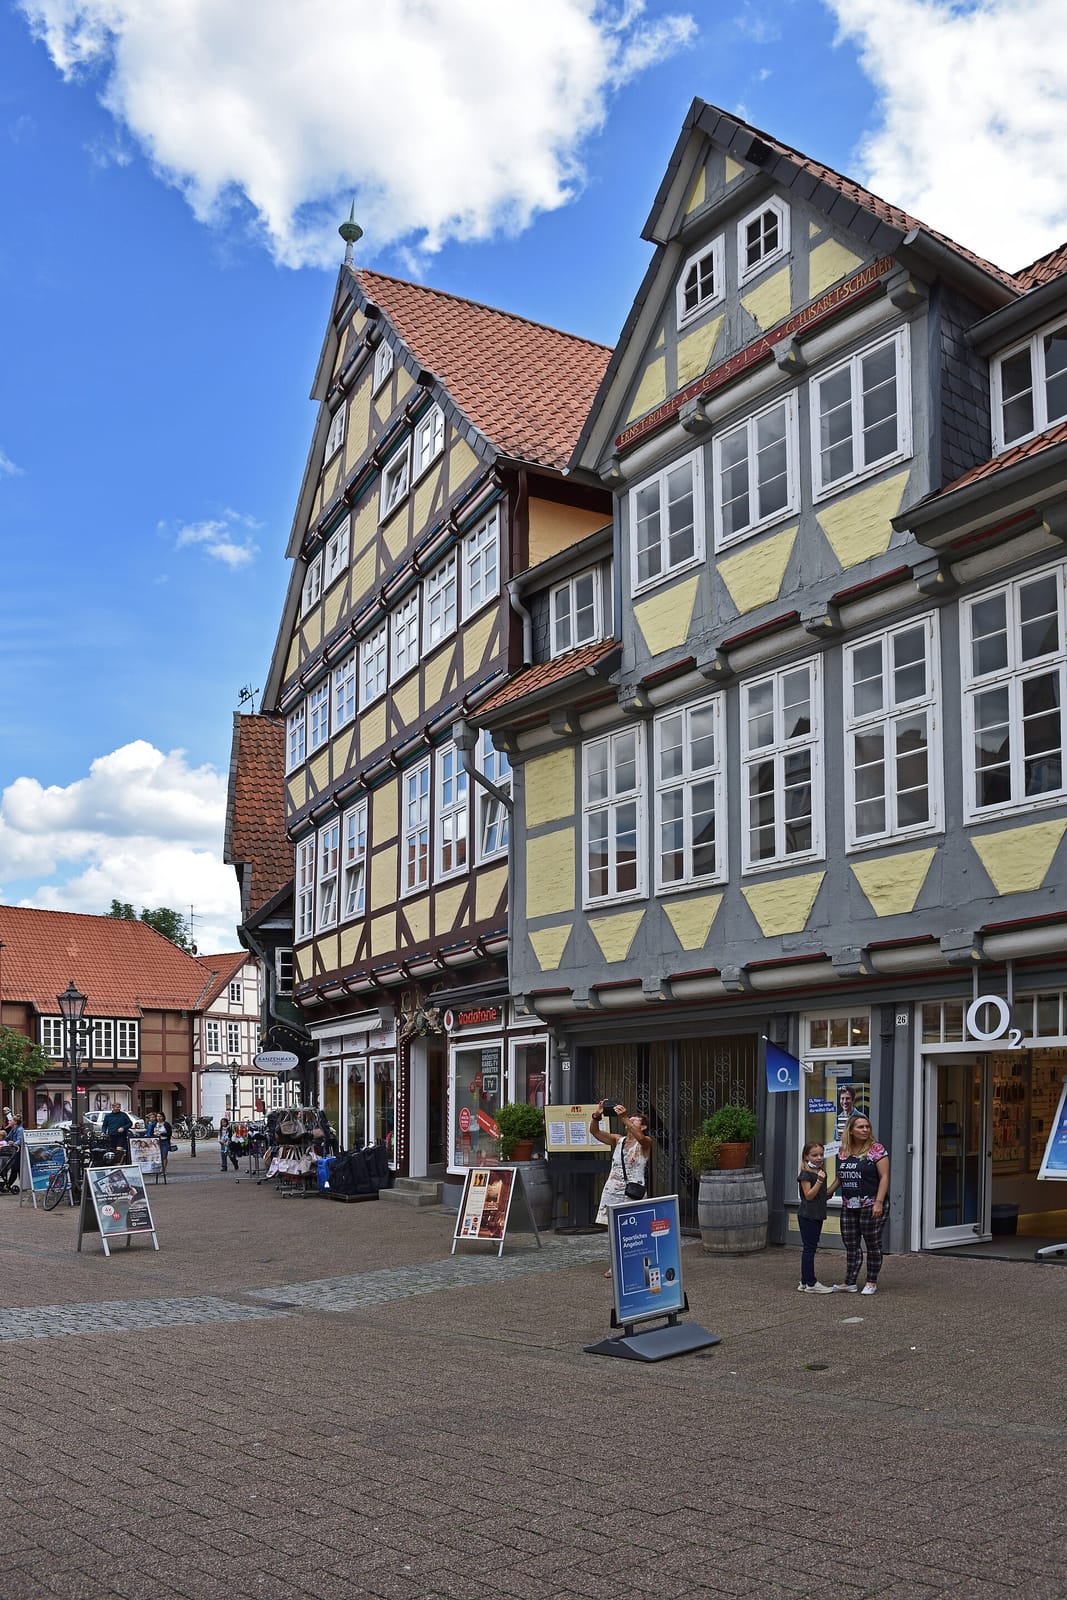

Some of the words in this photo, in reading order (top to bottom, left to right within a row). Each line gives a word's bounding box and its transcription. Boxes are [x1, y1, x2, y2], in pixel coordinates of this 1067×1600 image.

[620, 420, 646, 444] ERNST
[458, 1007, 497, 1025] vodafone
[897, 1015, 906, 1024] 26
[967, 995, 1025, 1050] O2
[563, 1062, 570, 1070] 25
[777, 1067, 793, 1086] O2
[622, 1233, 648, 1243] Sportliches
[623, 1240, 644, 1249] Angebot
